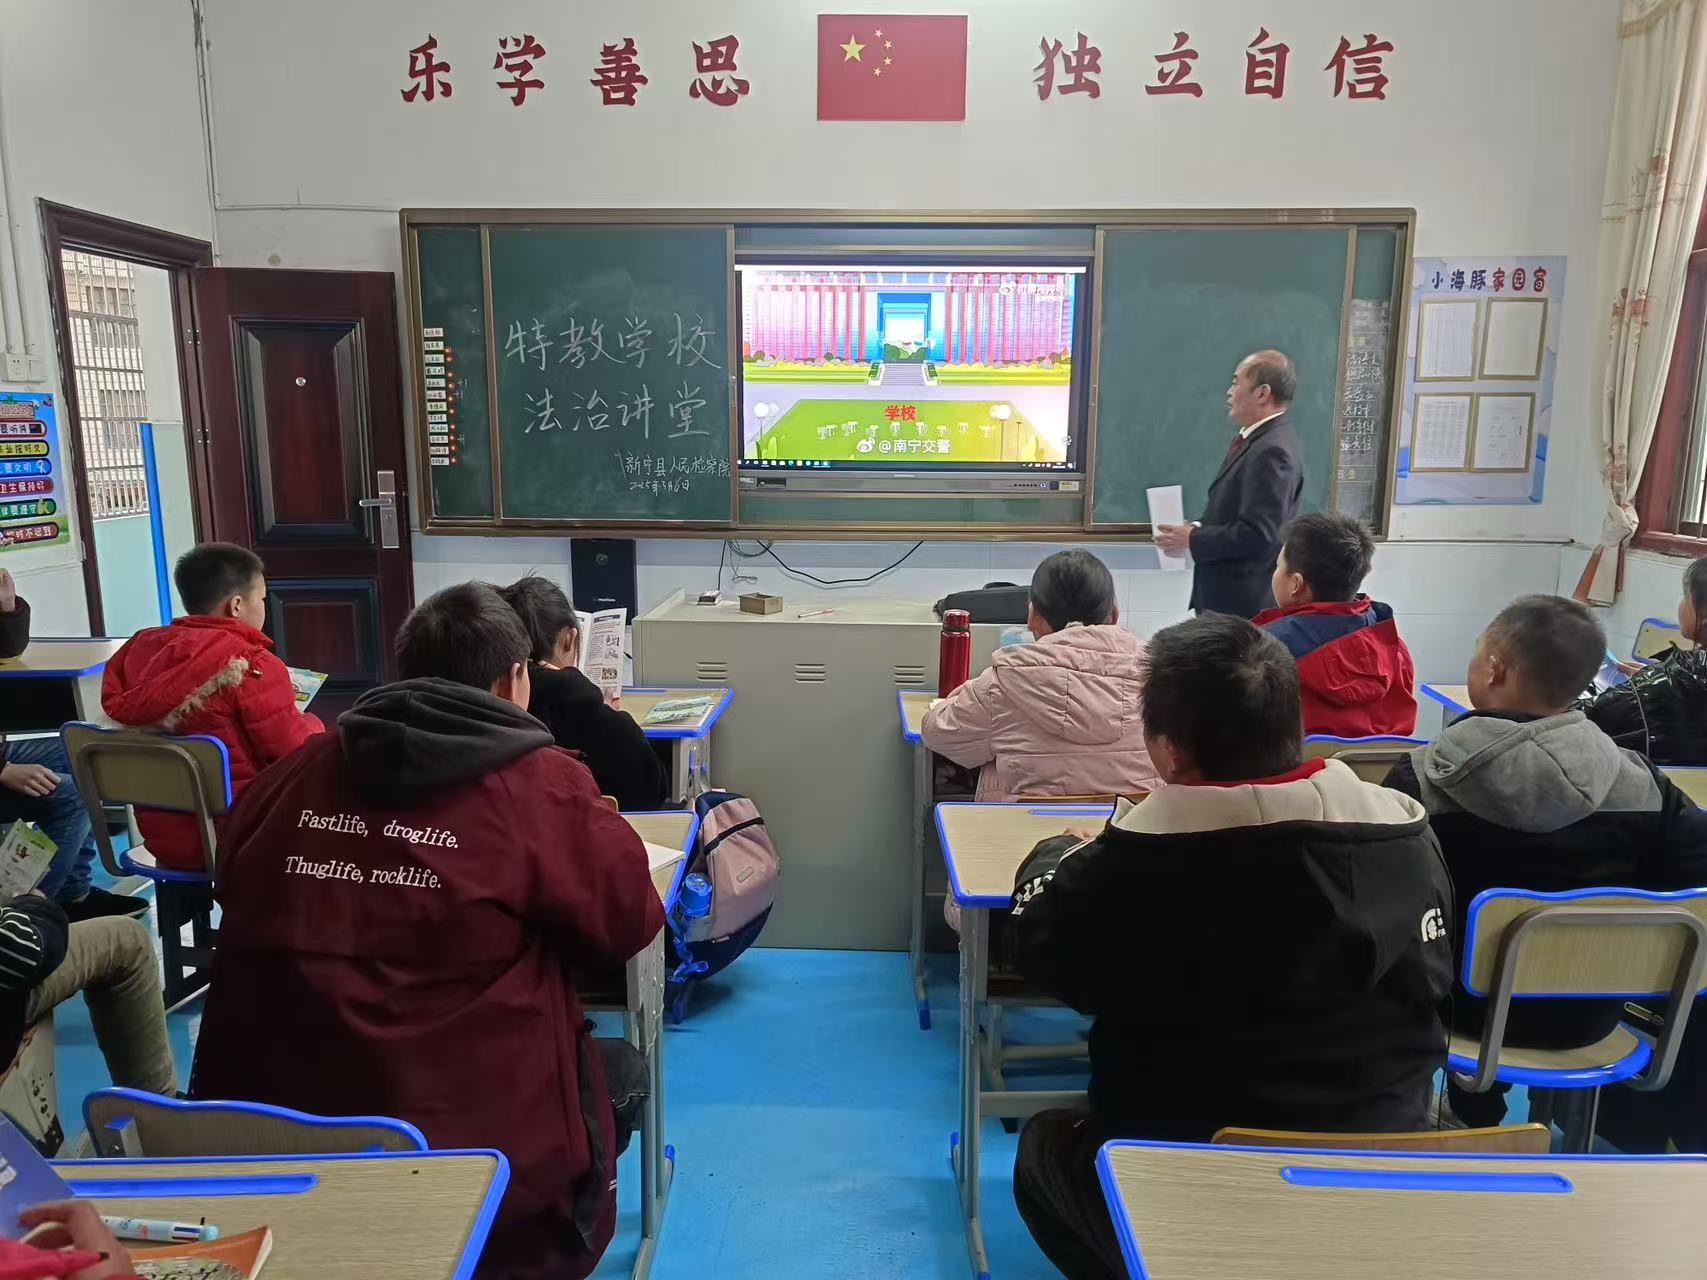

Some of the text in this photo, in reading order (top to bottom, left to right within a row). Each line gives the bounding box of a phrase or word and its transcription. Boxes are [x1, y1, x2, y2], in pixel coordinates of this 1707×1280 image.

[400, 33, 750, 107] 乐学善思
[1033, 26, 1394, 101] 独立自信
[1432, 266, 1547, 293] 小海豚家园窗
[504, 312, 722, 371] 特教学校
[524, 379, 710, 439] 法治讲堂
[885, 404, 917, 422] 学校
[624, 452, 731, 478] 新宁县人民检察院
[879, 439, 951, 454] @南宁交警
[298, 809, 460, 849] Fastlife, droglife.
[284, 855, 443, 889] Thuglife, rocklife.
